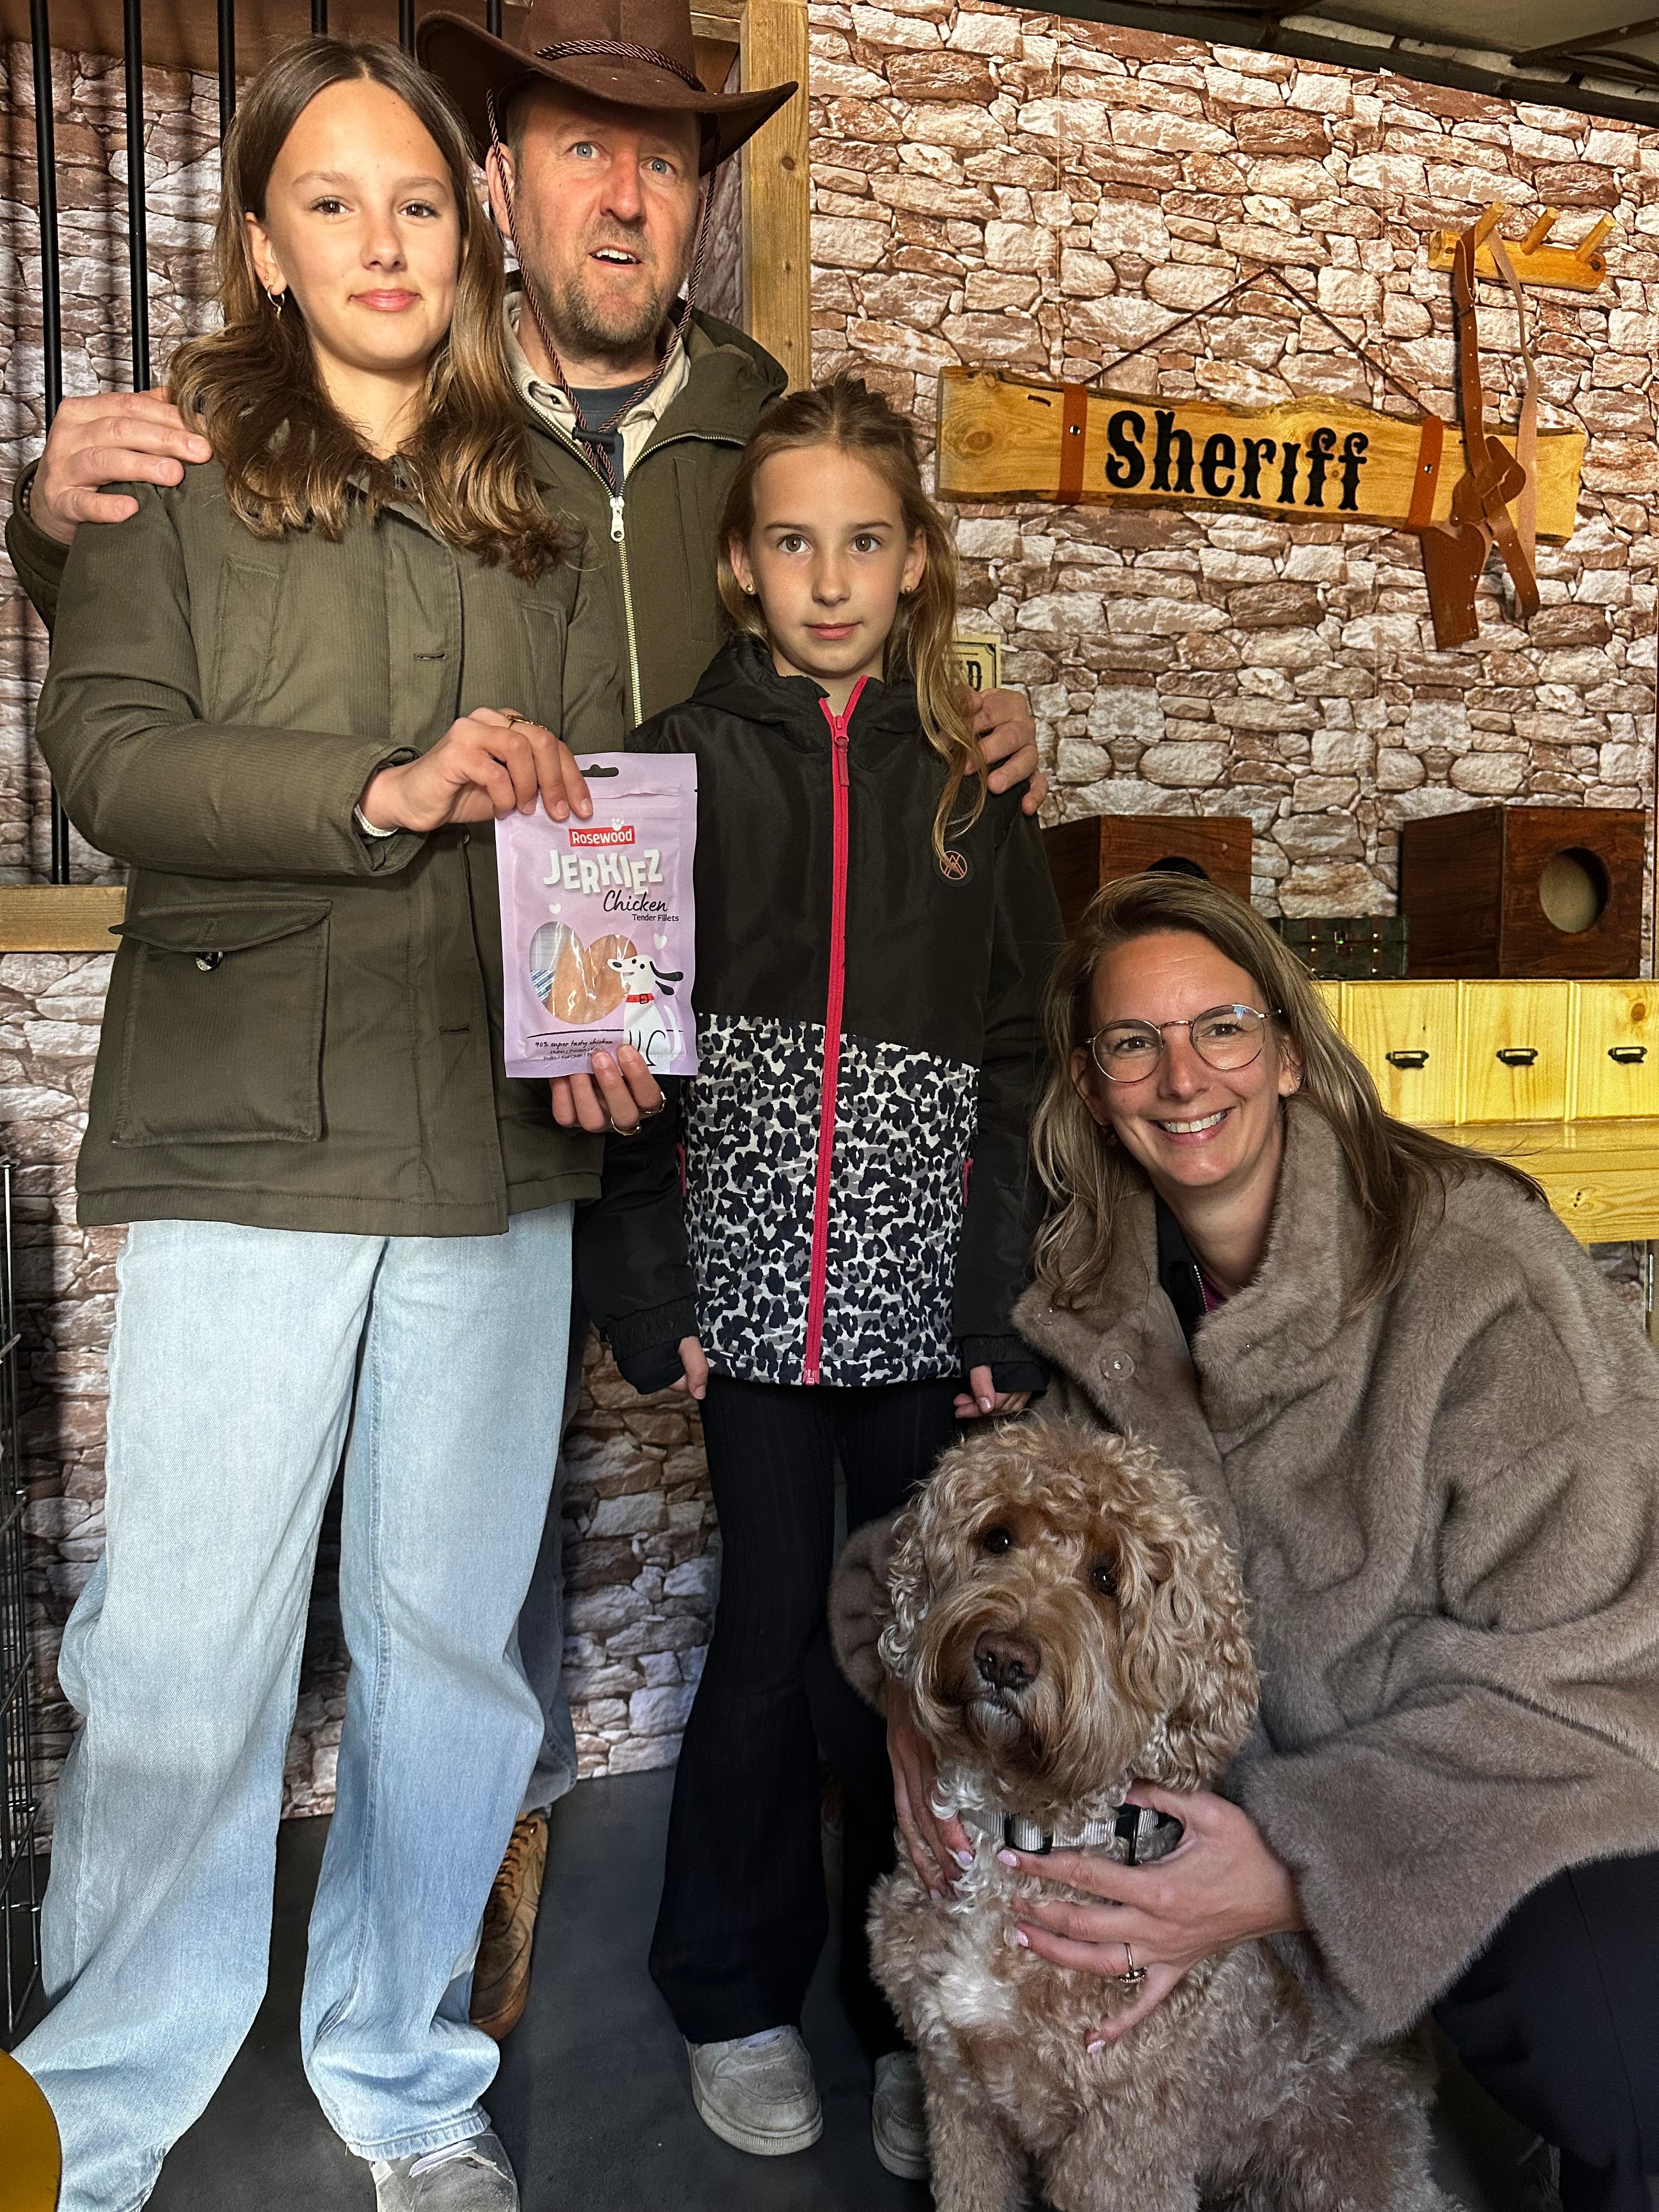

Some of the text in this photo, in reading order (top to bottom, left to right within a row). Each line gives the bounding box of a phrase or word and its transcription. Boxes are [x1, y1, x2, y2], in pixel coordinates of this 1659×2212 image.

[1105, 410, 1369, 511] Sheriff
[572, 828, 633, 844] Rosewood
[543, 849, 663, 895] JERKIEZ
[603, 889, 668, 912] Chicken
